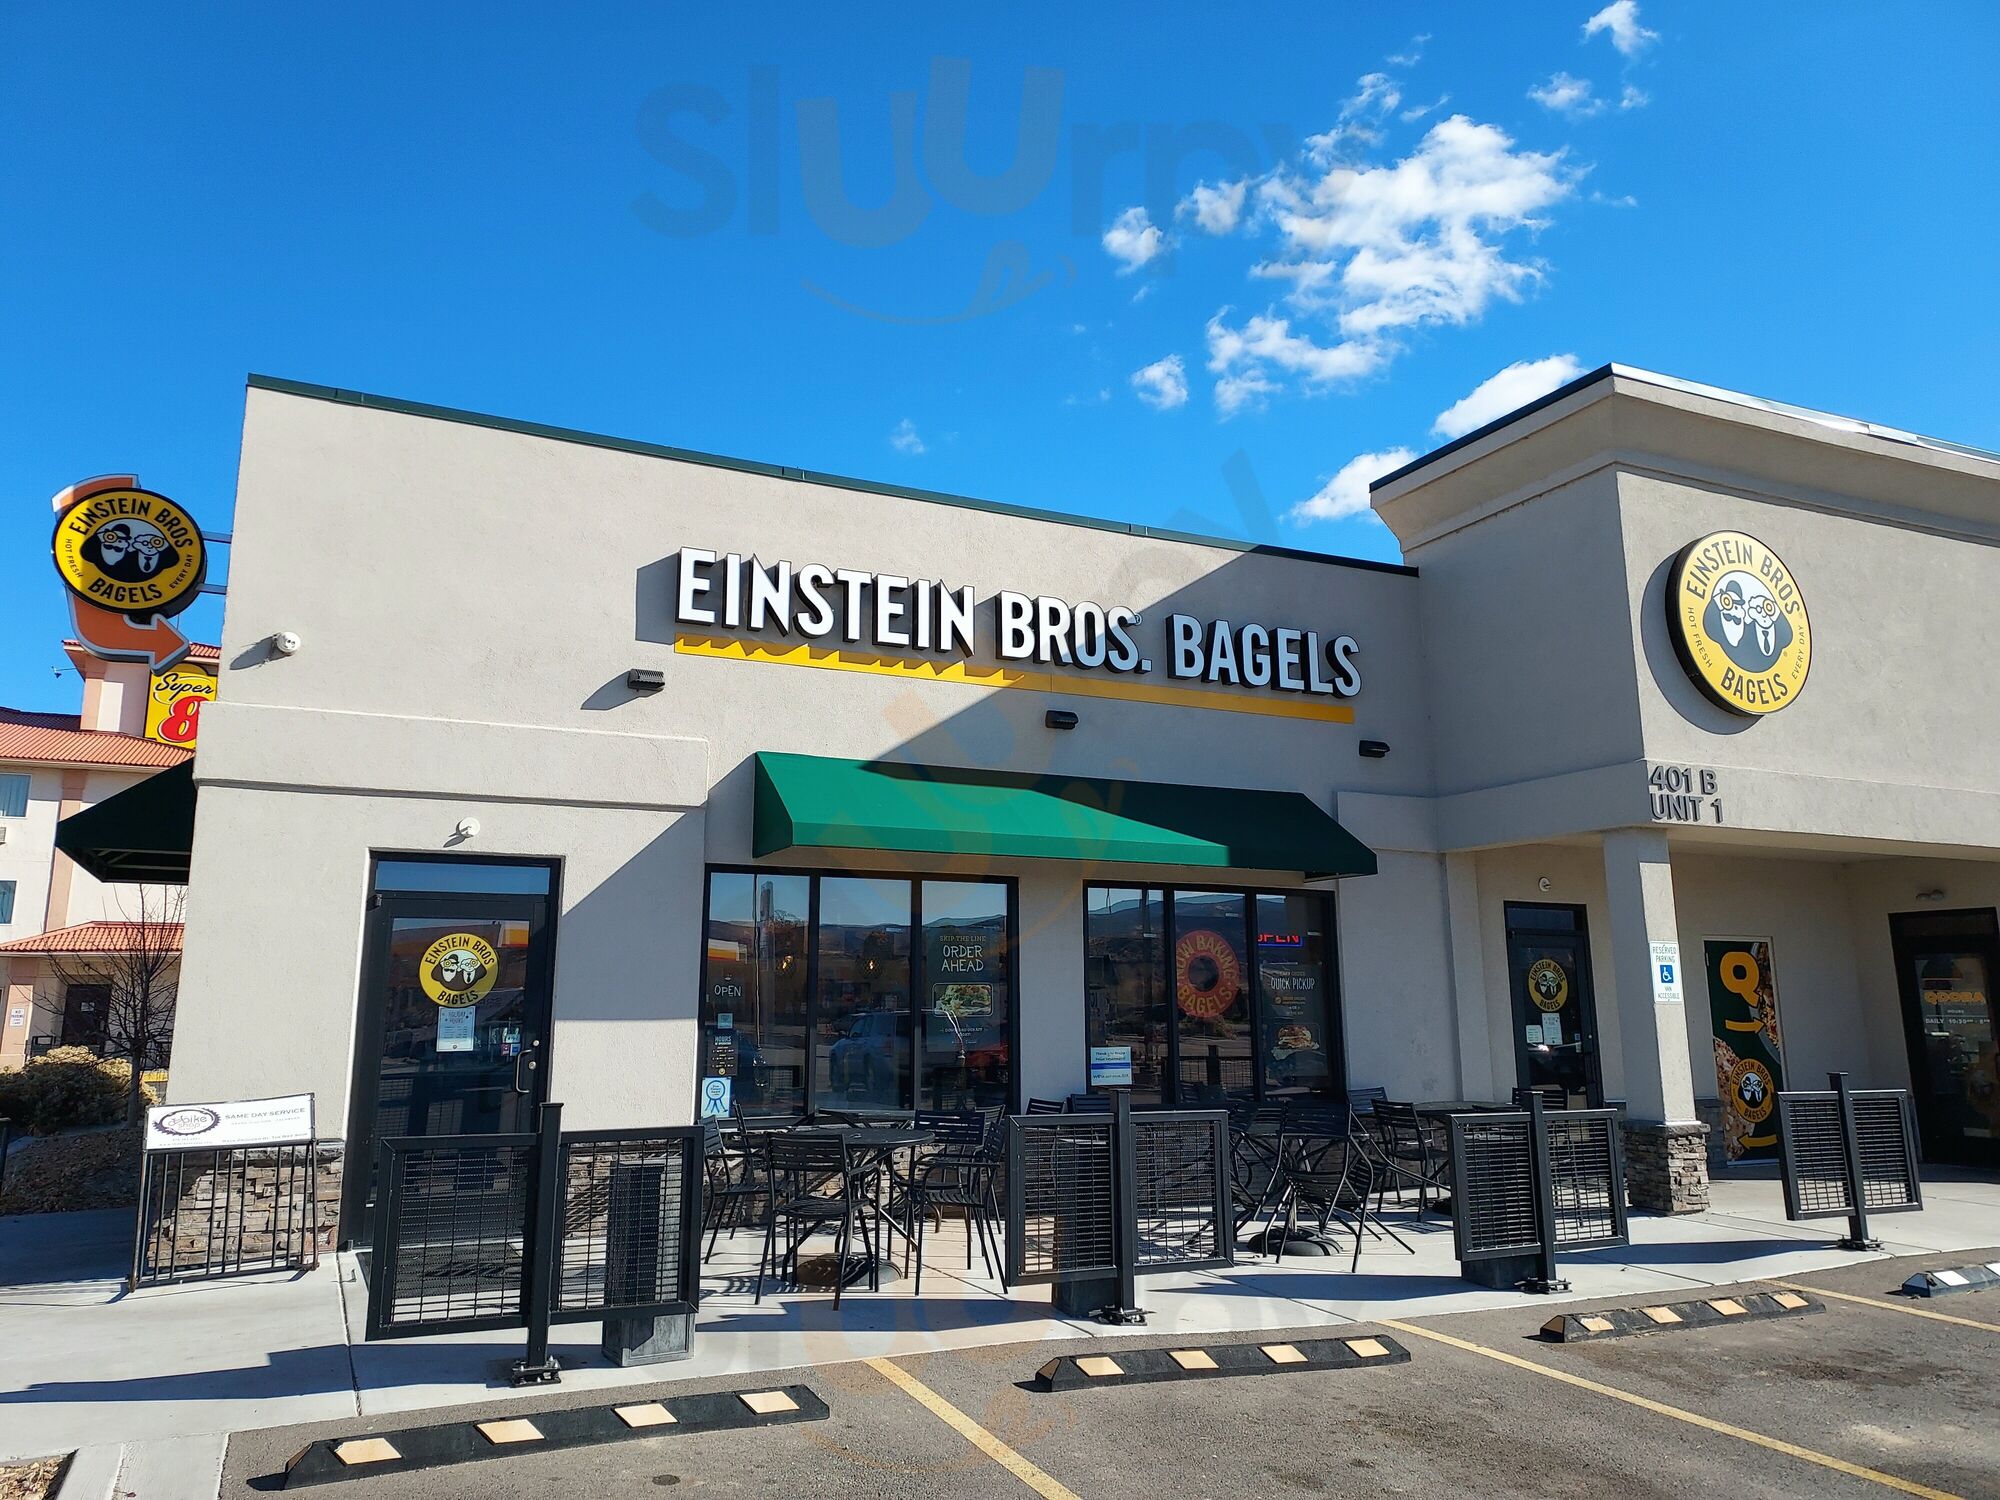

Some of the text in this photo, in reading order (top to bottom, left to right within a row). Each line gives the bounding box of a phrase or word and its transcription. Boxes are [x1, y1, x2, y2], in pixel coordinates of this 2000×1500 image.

[69, 498, 193, 548] EINSTEIN BROS
[65, 538, 84, 579] HOT FRESH
[169, 553, 193, 589] EVERY DAY
[87, 577, 163, 603] BAGELS
[1686, 540, 1800, 615] EINSTEIN BROS
[676, 546, 976, 657] EINSTEIN
[1168, 613, 1362, 698] BAGELS
[1687, 606, 1712, 668] HOT FRESH
[1792, 648, 1805, 680] EVERY
[155, 673, 214, 701] Super
[1720, 666, 1788, 705] BAGELS
[157, 696, 209, 742] 8
[1650, 765, 1718, 795] 401 B
[1650, 793, 1723, 823] UNIT 1
[425, 936, 495, 965] EINSTEIN BROS
[943, 944, 983, 958] ORDER
[1196, 935, 1236, 980] BAKING
[1652, 946, 1677, 954] RESERVED
[1655, 955, 1676, 963] PARKING
[941, 959, 984, 972] AHEAD
[1530, 961, 1566, 982] EINSTEIN BROS
[437, 989, 479, 1005] BAGELS
[714, 984, 741, 997] OPEN
[1270, 977, 1315, 990] QUICK PICKUP
[1178, 985, 1233, 1013] BAGELS
[1539, 999, 1561, 1010] BAGELS
[1923, 991, 1987, 1006] QDOBA
[1732, 1060, 1771, 1086] EINSTEIN BROS
[268, 1107, 306, 1117] SERVICE
[1743, 1106, 1767, 1120] BAGELS
